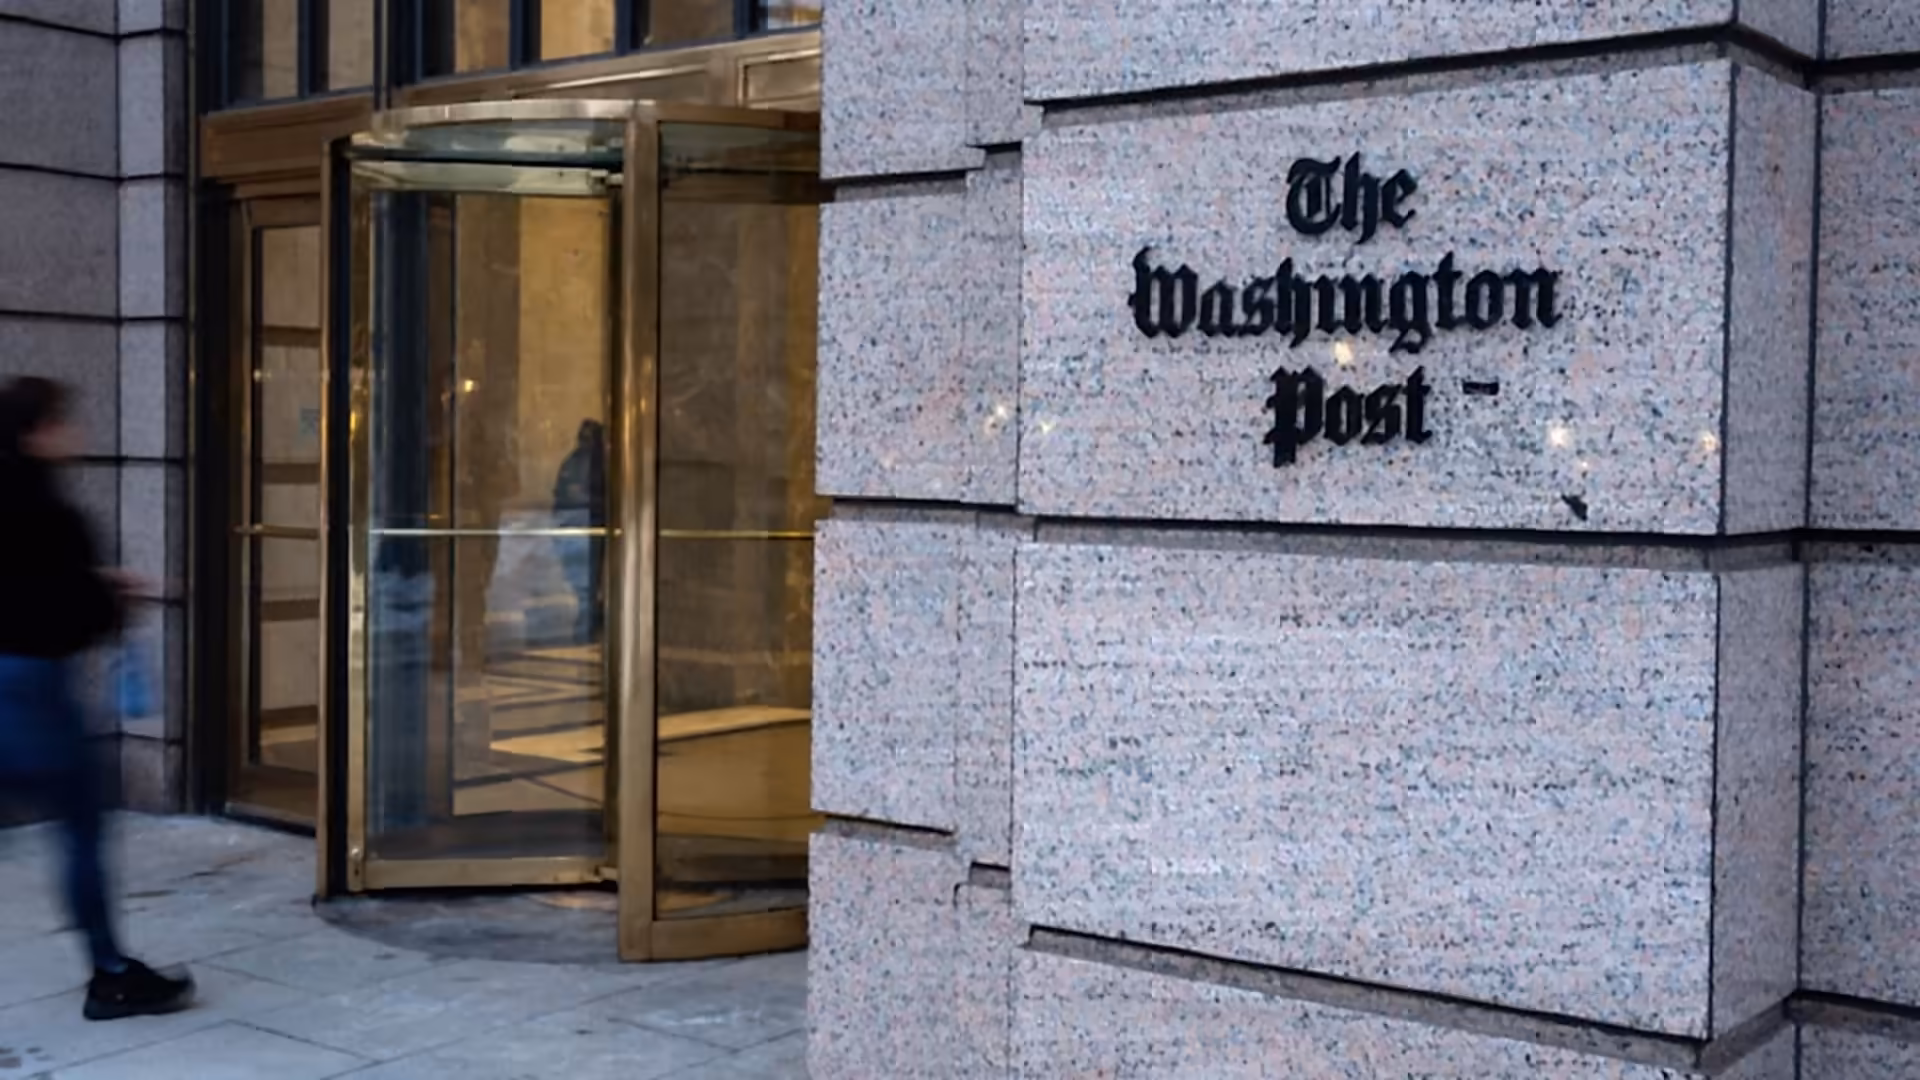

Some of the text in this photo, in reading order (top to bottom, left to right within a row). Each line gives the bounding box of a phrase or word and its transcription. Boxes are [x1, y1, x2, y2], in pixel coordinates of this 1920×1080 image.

[1285, 151, 1417, 245] The
[1127, 247, 1563, 354] Washington
[1263, 366, 1433, 468] Post
